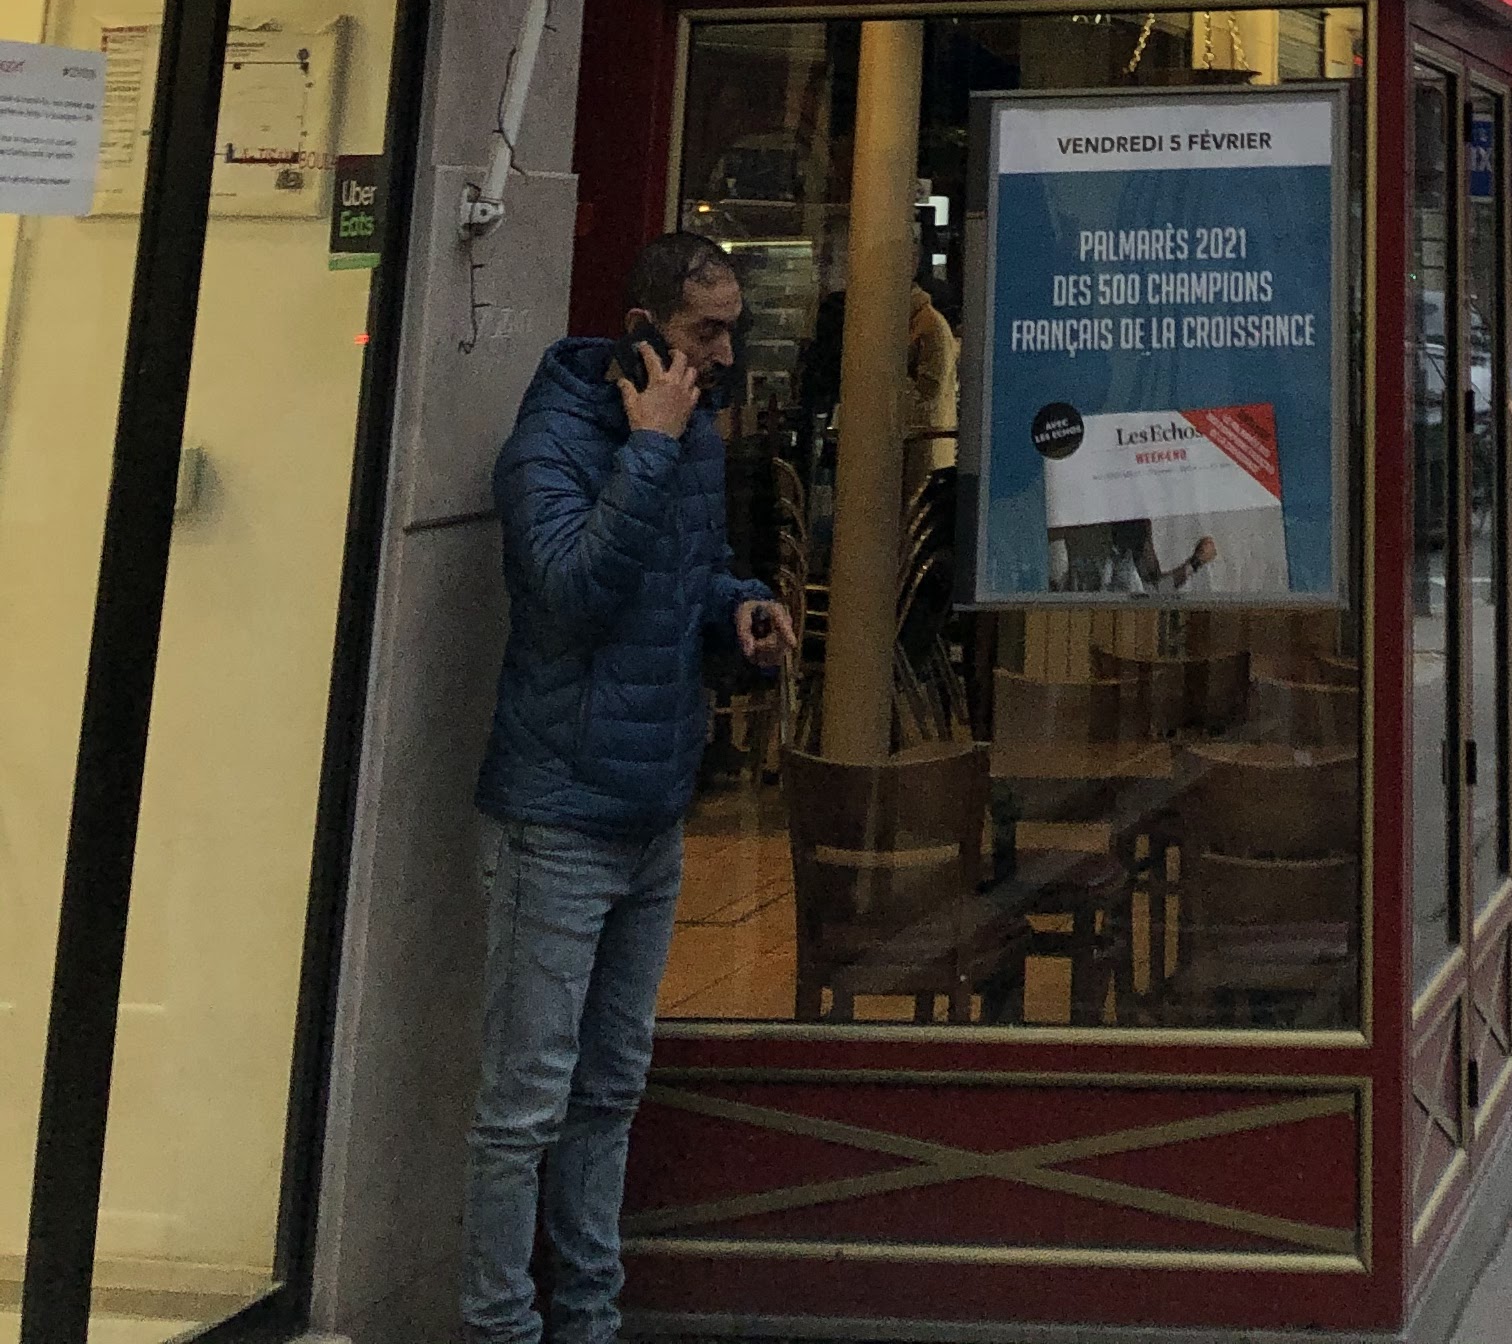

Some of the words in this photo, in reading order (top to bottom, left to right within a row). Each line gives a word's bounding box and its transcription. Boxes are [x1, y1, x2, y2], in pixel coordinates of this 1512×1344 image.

[1057, 134, 1164, 155] VENDREDI
[1169, 134, 1182, 152] 5
[1188, 128, 1273, 151] FÉVRIER
[341, 180, 377, 207] Uber
[339, 210, 375, 238] Eats
[1079, 223, 1189, 261] PALMARÈS
[1196, 227, 1247, 259] 2021
[1053, 275, 1092, 306] DES
[1099, 273, 1140, 305] 500
[1148, 270, 1274, 304] CHAMPIONS
[1011, 318, 1114, 359] FRANÇAIS
[1120, 317, 1146, 349] DE
[1152, 317, 1176, 349] LA
[1182, 313, 1316, 348] CROISSANCE
